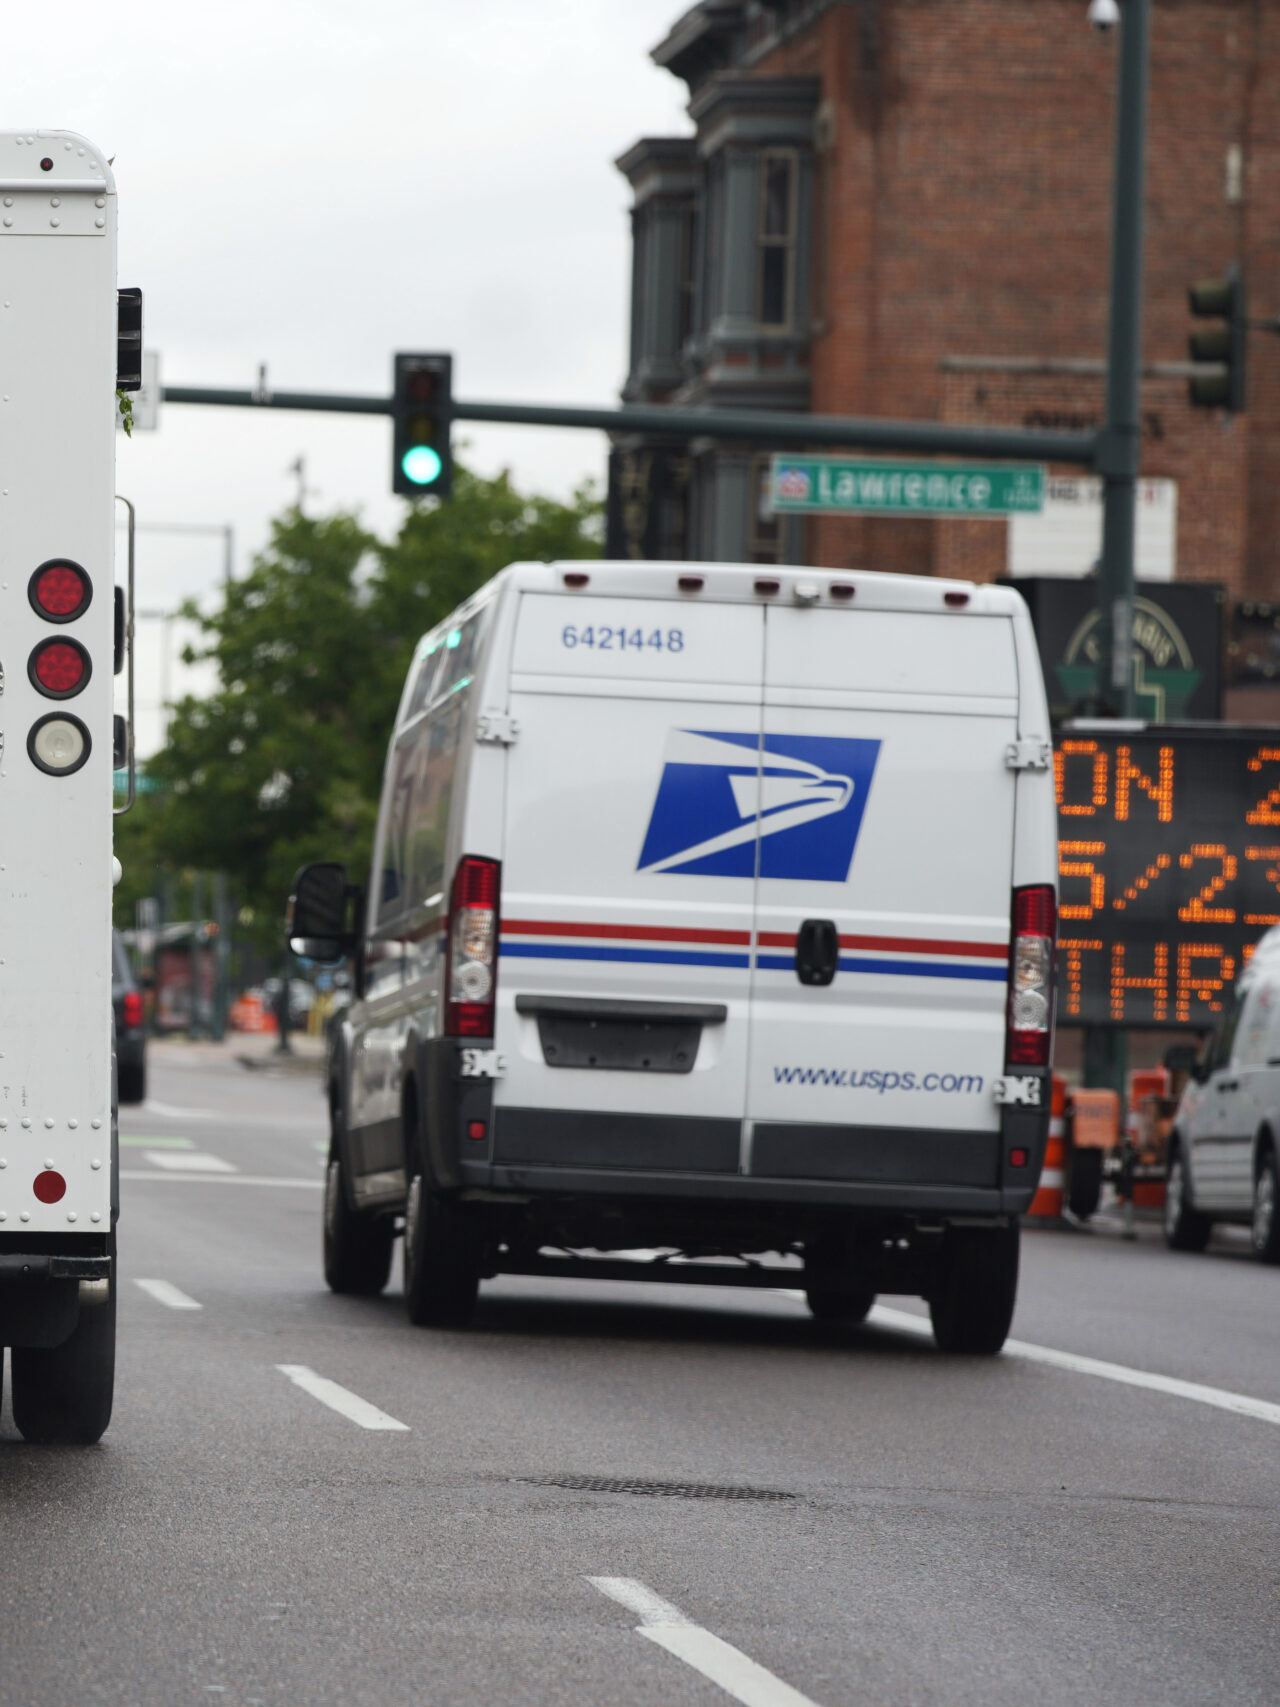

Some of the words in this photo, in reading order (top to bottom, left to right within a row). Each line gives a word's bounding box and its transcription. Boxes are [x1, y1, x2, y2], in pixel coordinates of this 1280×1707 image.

[817, 465, 992, 506] Lawrence
[562, 625, 684, 653] 6421448
[1053, 740, 1174, 822] ON
[1055, 938, 1260, 1023] THR
[773, 1066, 984, 1094] www.usps.com
